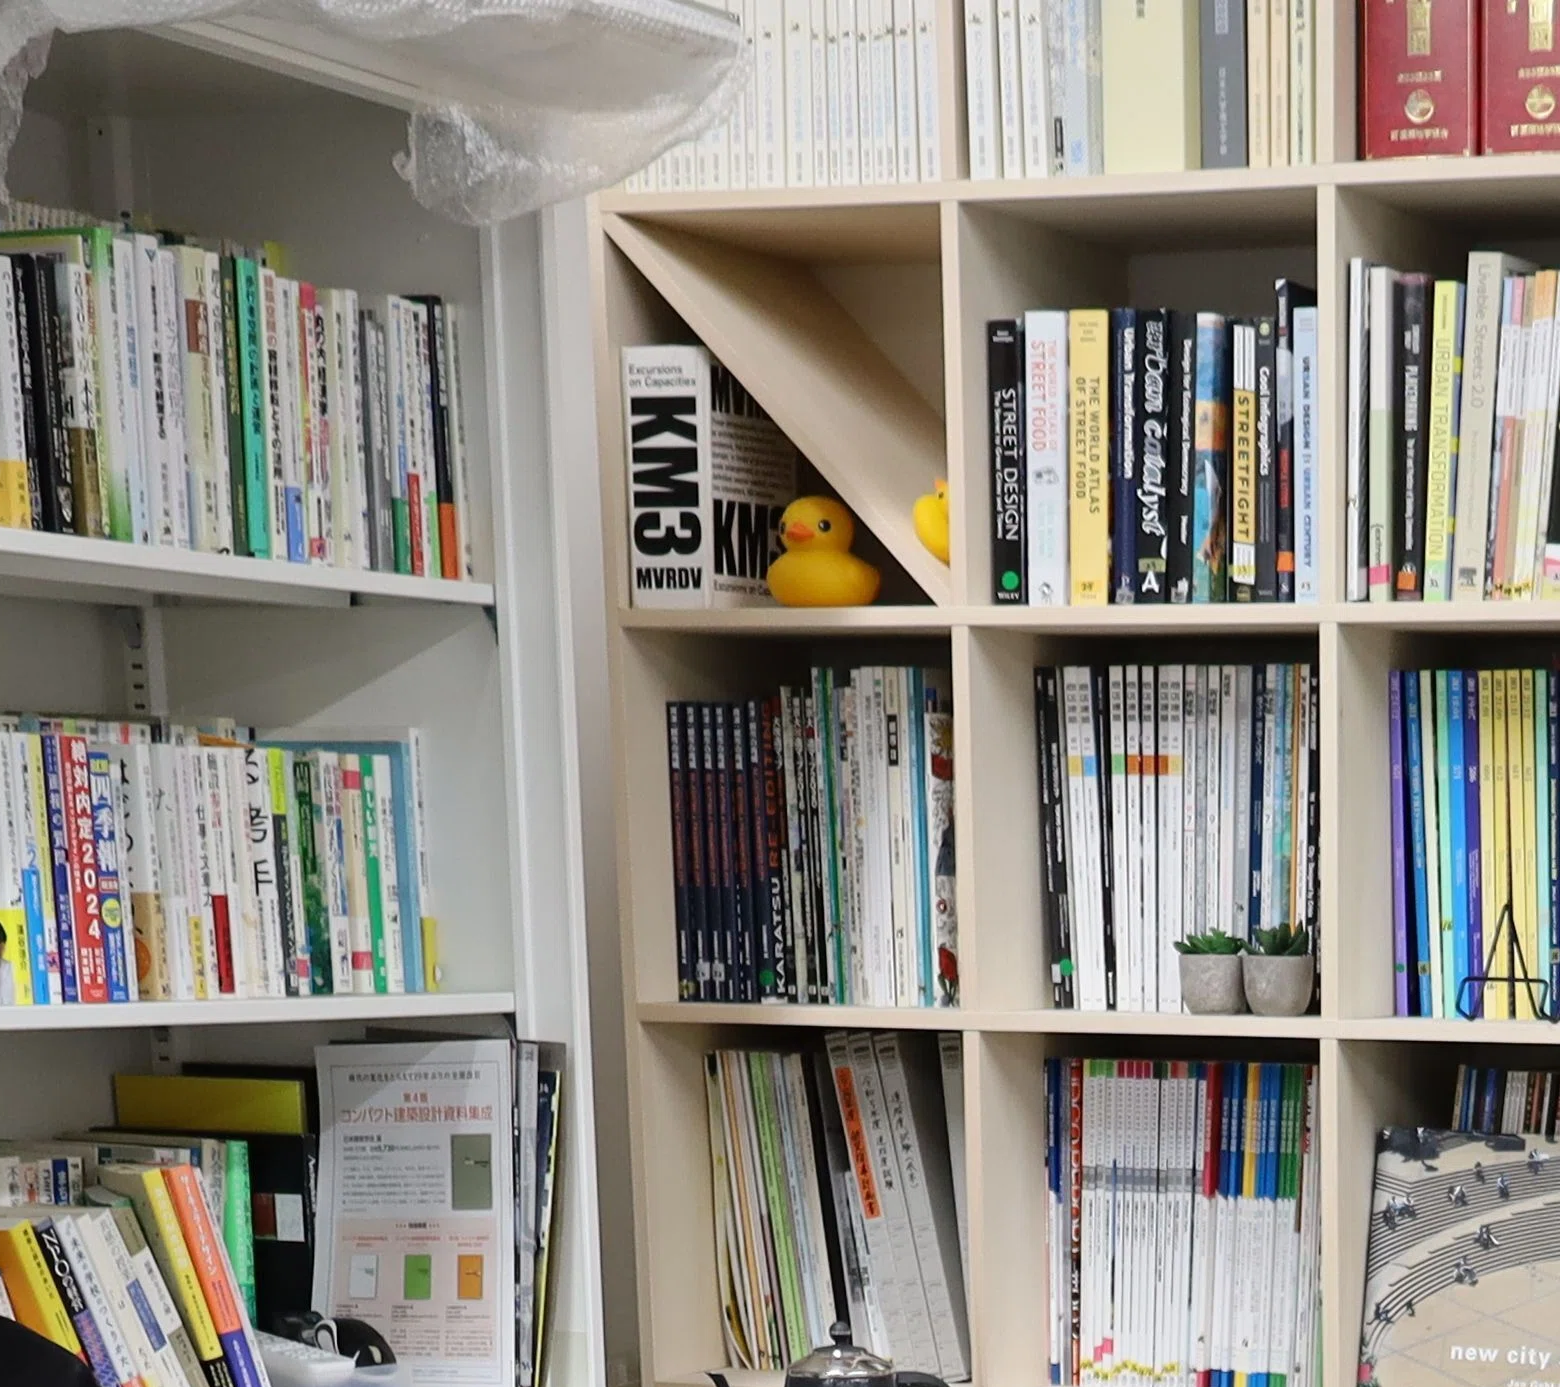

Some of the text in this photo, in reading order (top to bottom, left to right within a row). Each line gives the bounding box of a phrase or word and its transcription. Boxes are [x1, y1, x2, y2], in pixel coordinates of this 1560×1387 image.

[627, 364, 684, 376] Excursions
[628, 376, 697, 388] on Capacities
[1030, 339, 1047, 452] STREET FOOD
[629, 395, 703, 557] KM3
[1001, 387, 1019, 540] STREET DESIGN
[1075, 400, 1087, 499] STREET FOOD
[1089, 377, 1101, 514] THE WORLD ATLAS
[1237, 395, 1250, 539] STREETFIGHT
[1428, 338, 1451, 557] URBAN TRANSFORMATION
[635, 566, 703, 590] MVRDV
[997, 591, 1020, 600] WILEY
[69, 738, 102, 939] 絶対内定2024
[340, 1104, 494, 1125] コンパクト建築設計資料集成
[1451, 1345, 1496, 1363] new
[1508, 1347, 1550, 1374] city
